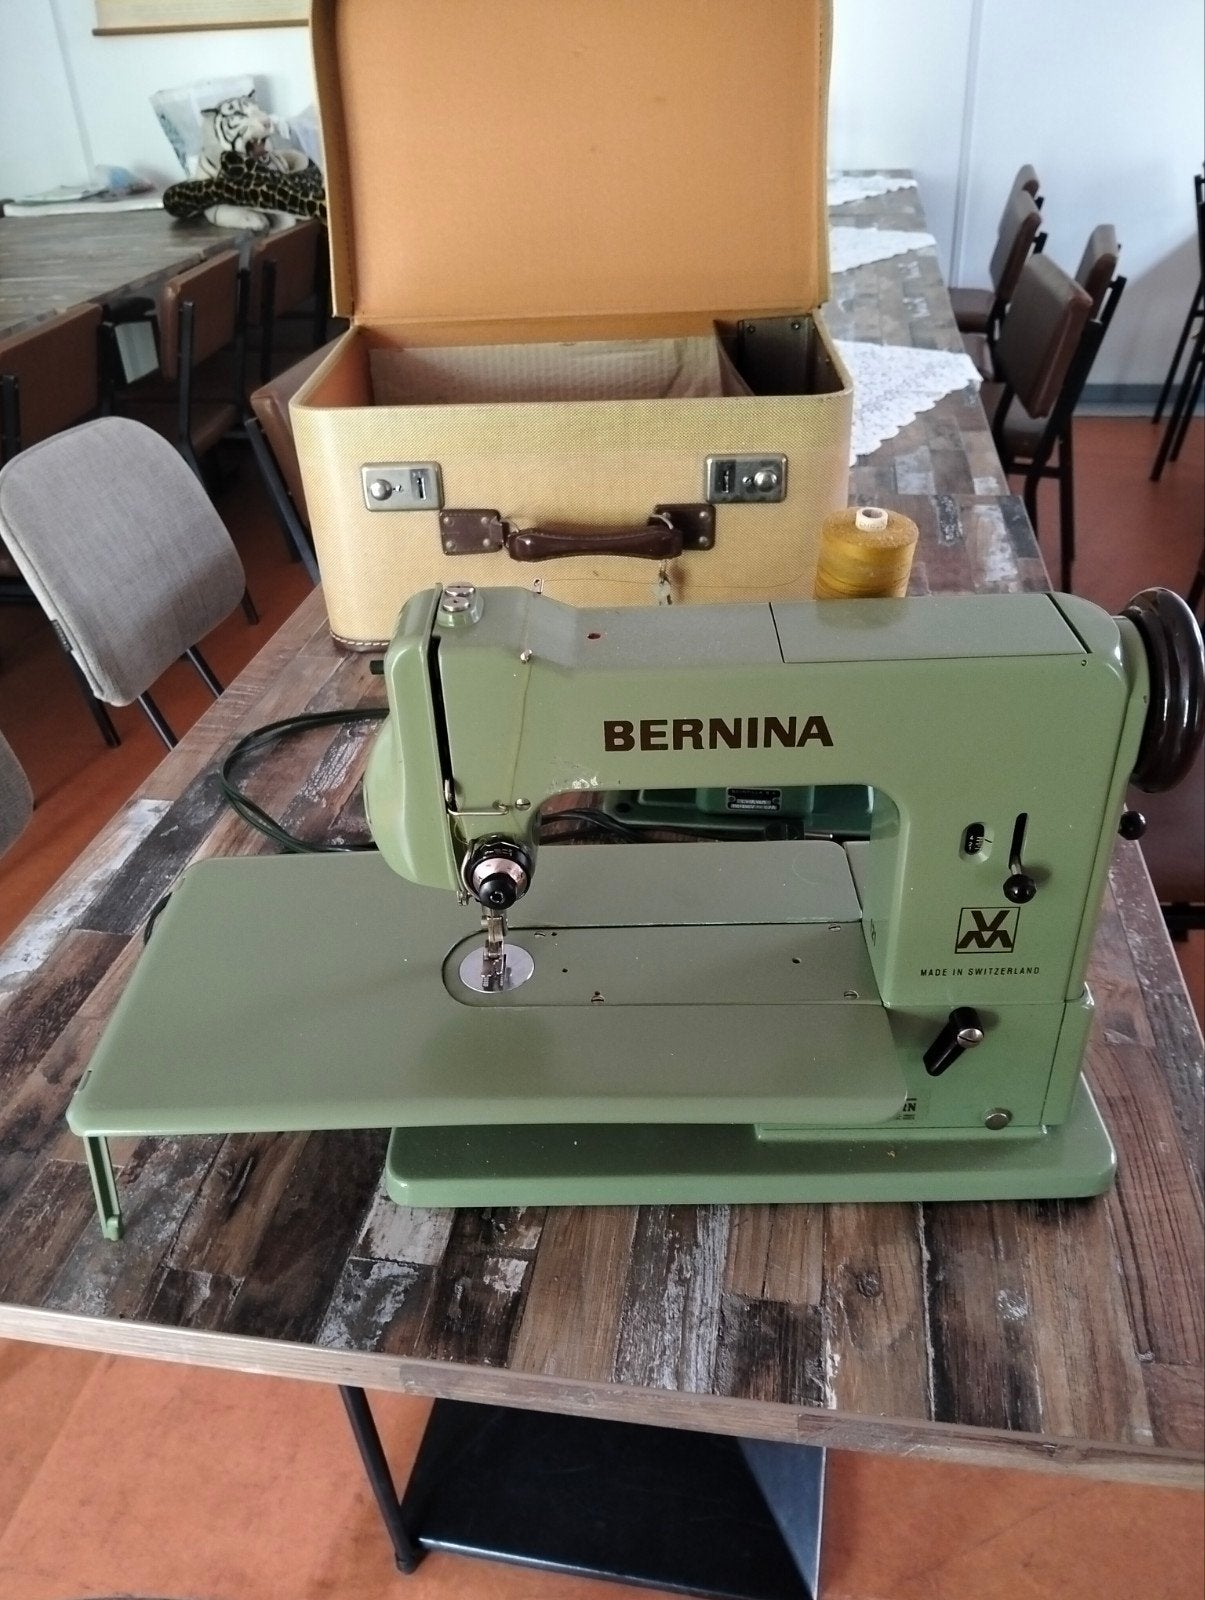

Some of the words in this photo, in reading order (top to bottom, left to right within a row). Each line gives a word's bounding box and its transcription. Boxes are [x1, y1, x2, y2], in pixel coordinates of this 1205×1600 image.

[603, 715, 834, 752] BERNINA
[920, 968, 948, 977] MADE
[952, 968, 963, 976] IN
[967, 966, 1040, 976] SWITZERLAND
